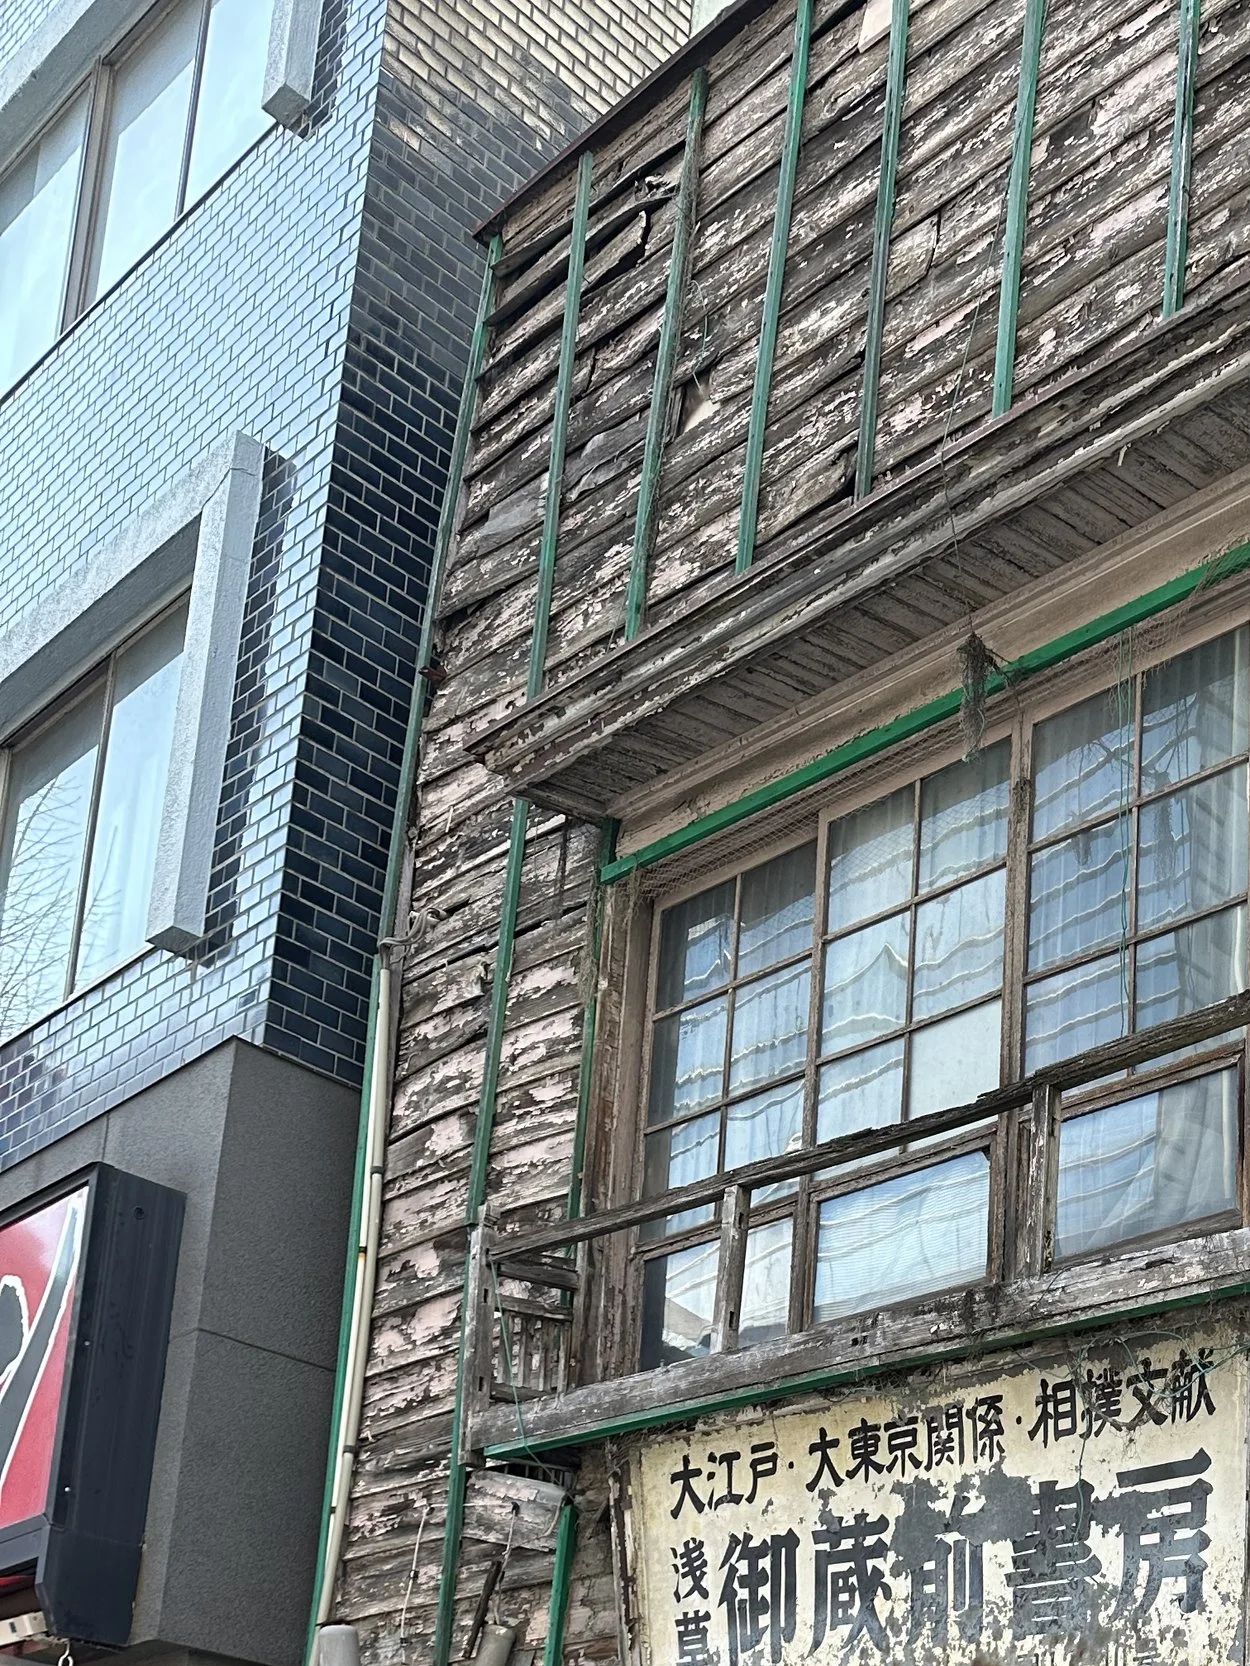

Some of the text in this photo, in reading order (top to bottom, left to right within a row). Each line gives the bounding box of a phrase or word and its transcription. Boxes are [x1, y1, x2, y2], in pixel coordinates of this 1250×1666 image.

[670, 1347, 1216, 1520] 大江戸・大東京関係・相撲文献
